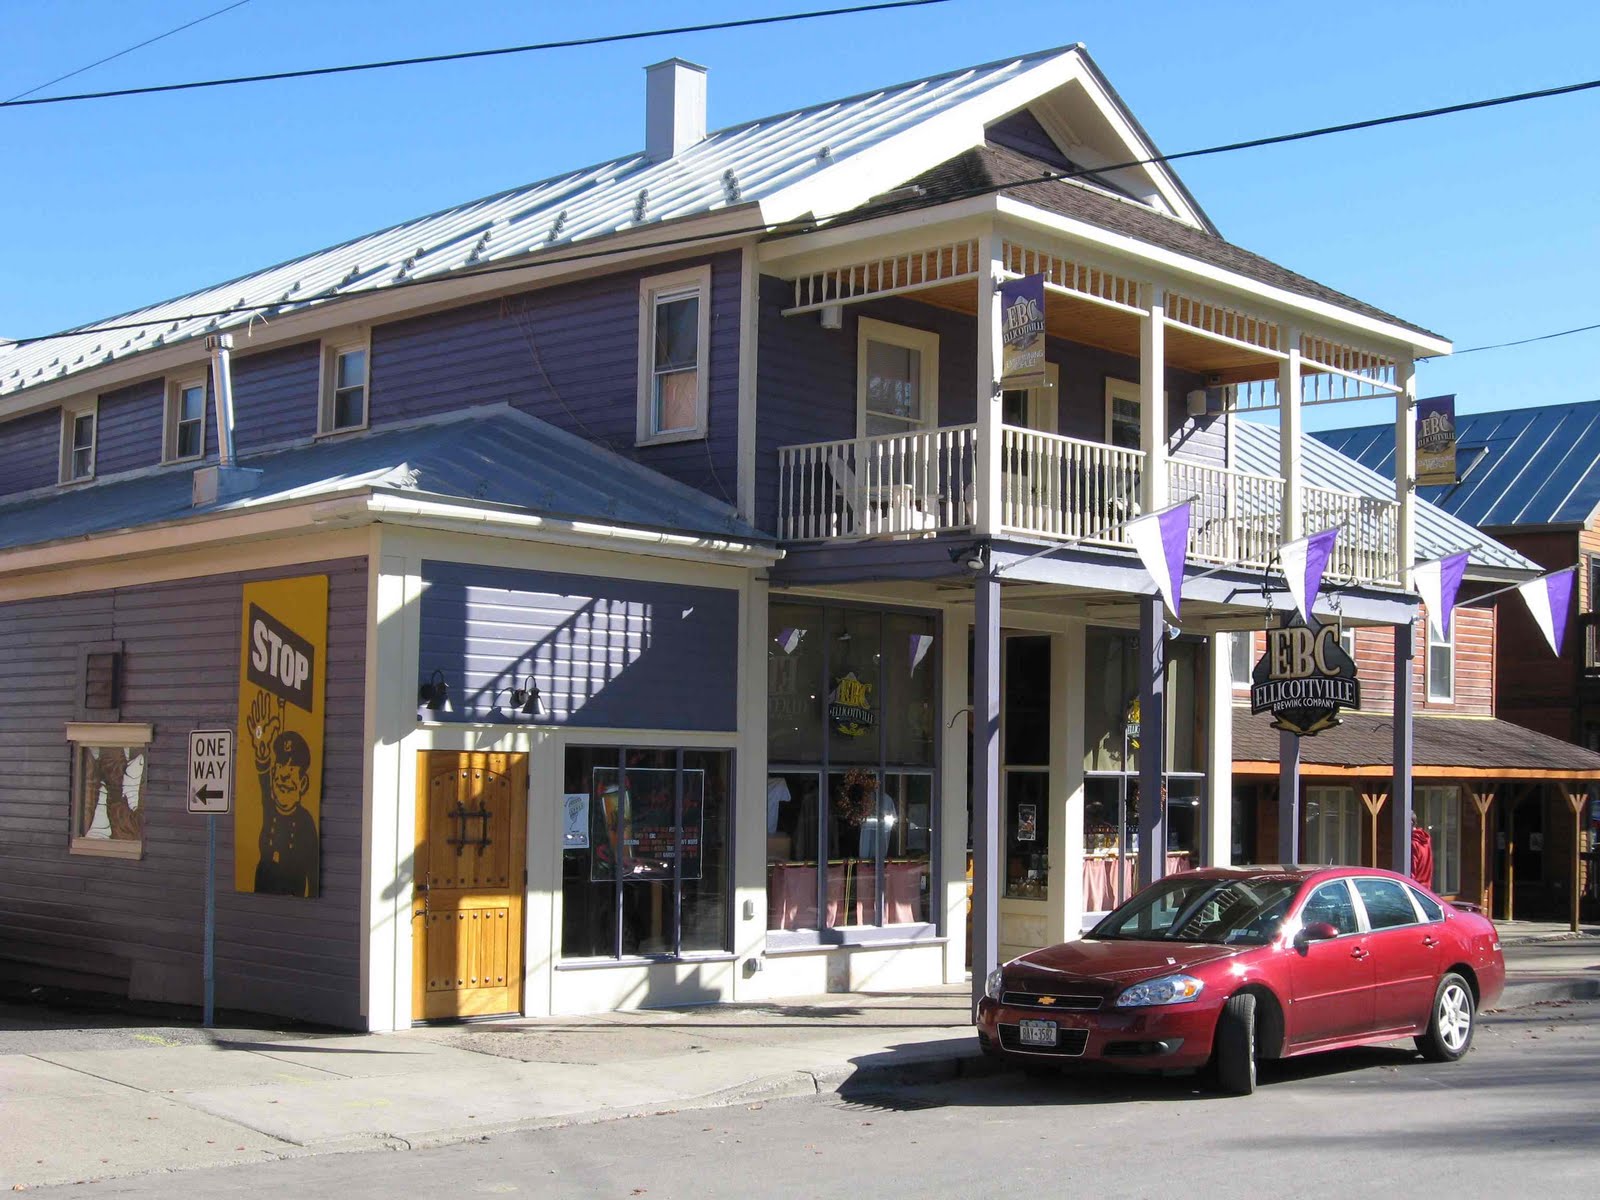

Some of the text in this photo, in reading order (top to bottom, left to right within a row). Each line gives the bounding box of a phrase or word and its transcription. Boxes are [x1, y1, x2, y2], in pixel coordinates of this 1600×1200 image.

[1006, 299, 1038, 329] EBC
[1421, 413, 1449, 437] EBC
[252, 619, 309, 691] STOP
[1268, 624, 1340, 679] EBC
[1255, 679, 1353, 707] ELLICOTTVILLE
[1273, 697, 1335, 712] BREWING COMPANY
[195, 737, 226, 757] ONE
[193, 760, 227, 779] WAY
